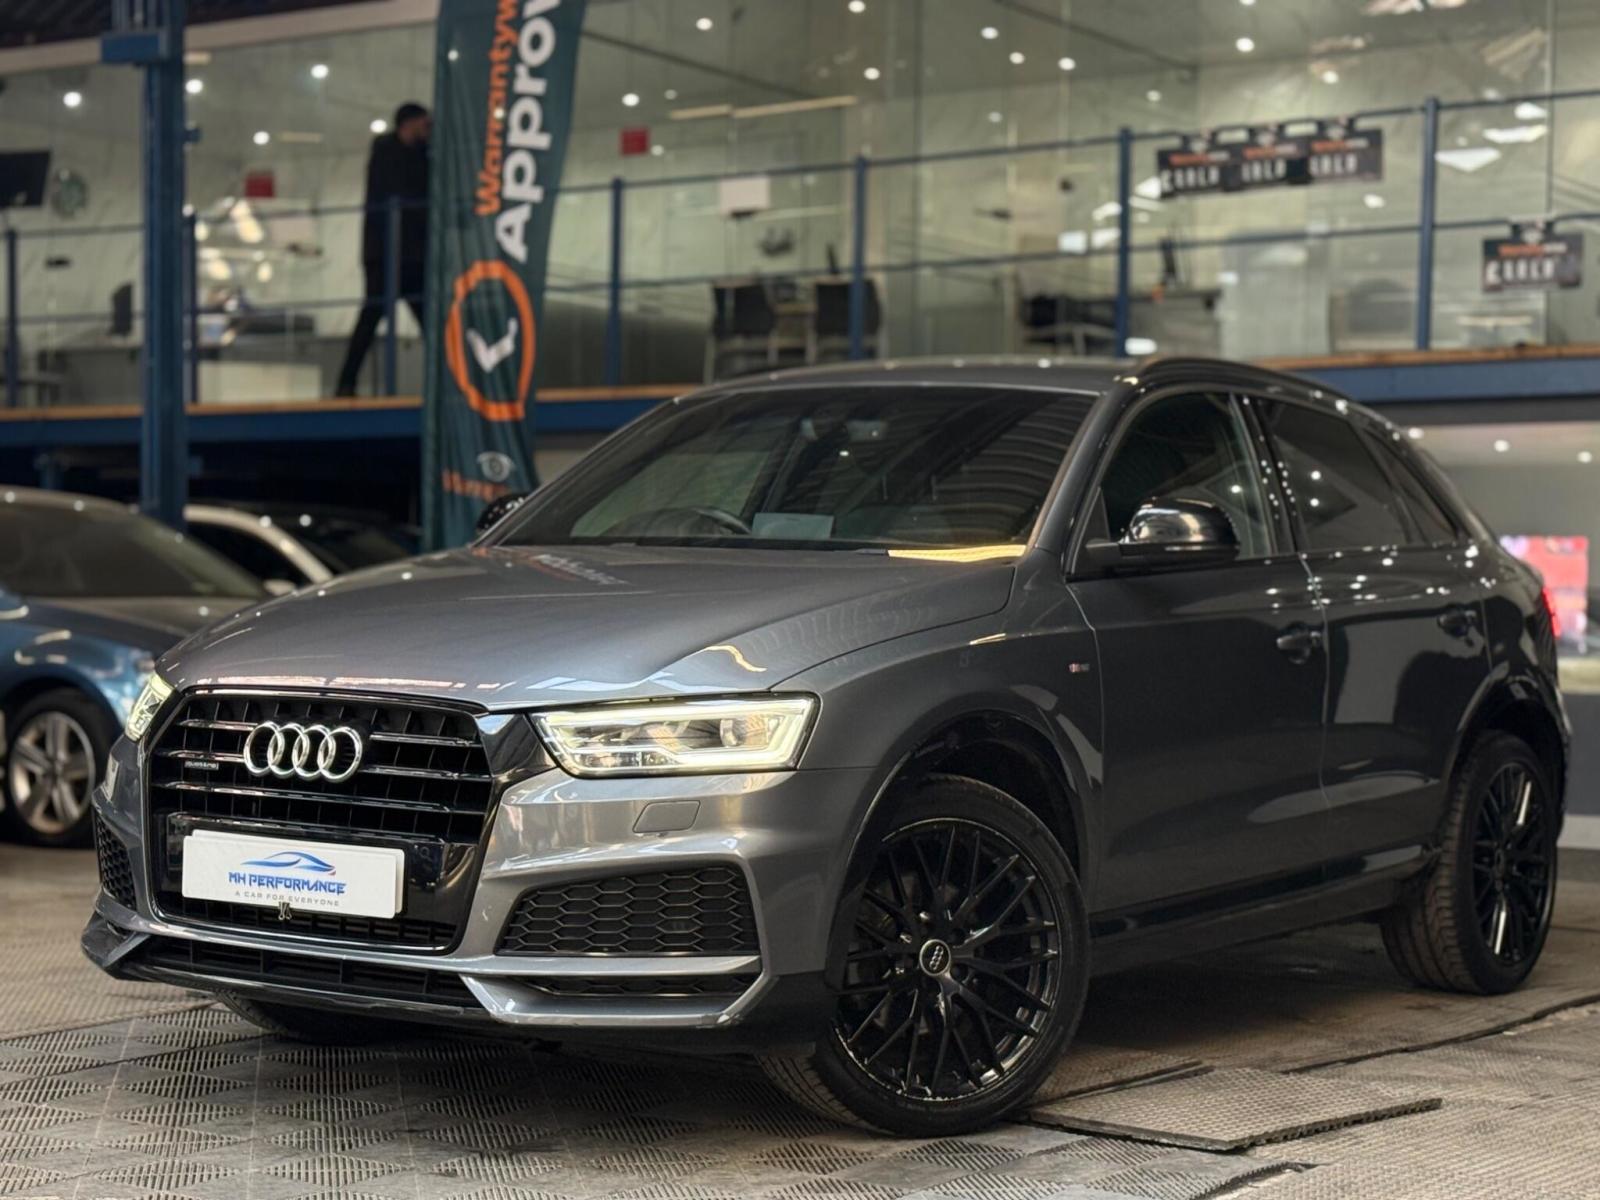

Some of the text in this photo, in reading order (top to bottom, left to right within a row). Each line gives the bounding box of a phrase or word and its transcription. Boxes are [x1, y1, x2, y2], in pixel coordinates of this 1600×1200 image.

[228, 871, 346, 895] MH PERFORMANCE
[244, 890, 263, 899] CAR
[266, 893, 285, 902] FOR
[288, 895, 340, 907] EVERYONE
